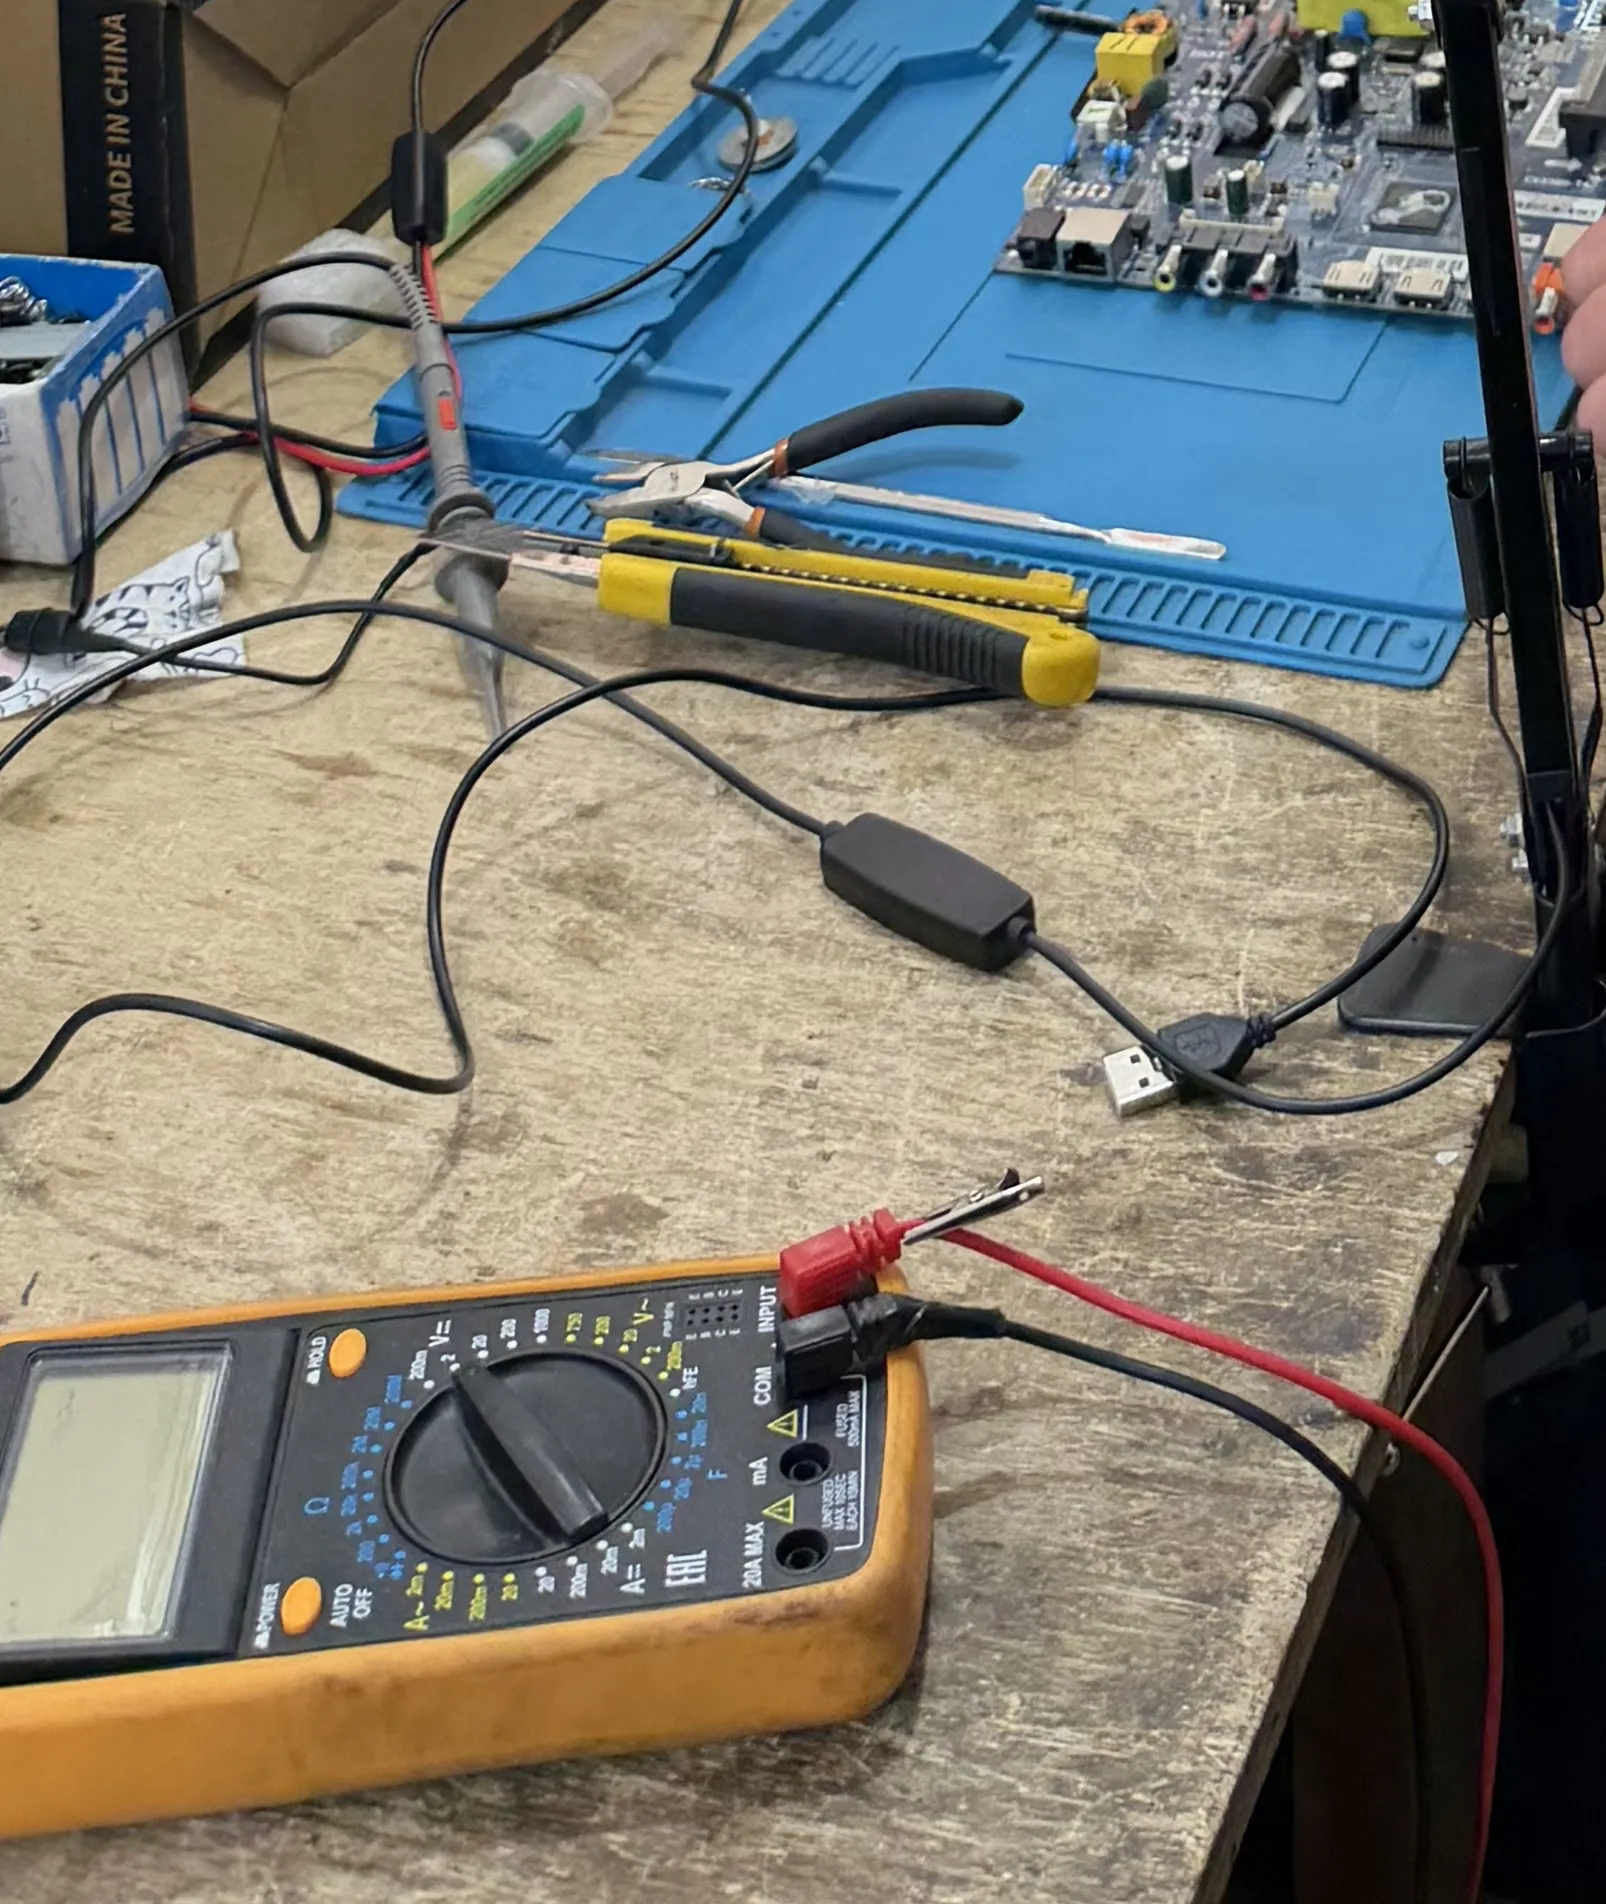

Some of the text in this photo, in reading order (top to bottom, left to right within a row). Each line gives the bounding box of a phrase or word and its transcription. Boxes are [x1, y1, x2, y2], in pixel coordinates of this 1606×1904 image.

[102, 12, 135, 235] MADE IN CHINA
[757, 1285, 777, 1333] INPUT
[307, 1336, 327, 1369] HOLD
[753, 1366, 772, 1406] COM
[707, 1468, 728, 1480] F
[748, 1456, 768, 1486] mA
[742, 1521, 765, 1588] 20A MAX
[256, 1582, 281, 1632] POWER
[329, 1583, 353, 1628] AUTO
[352, 1587, 373, 1620] OFF
